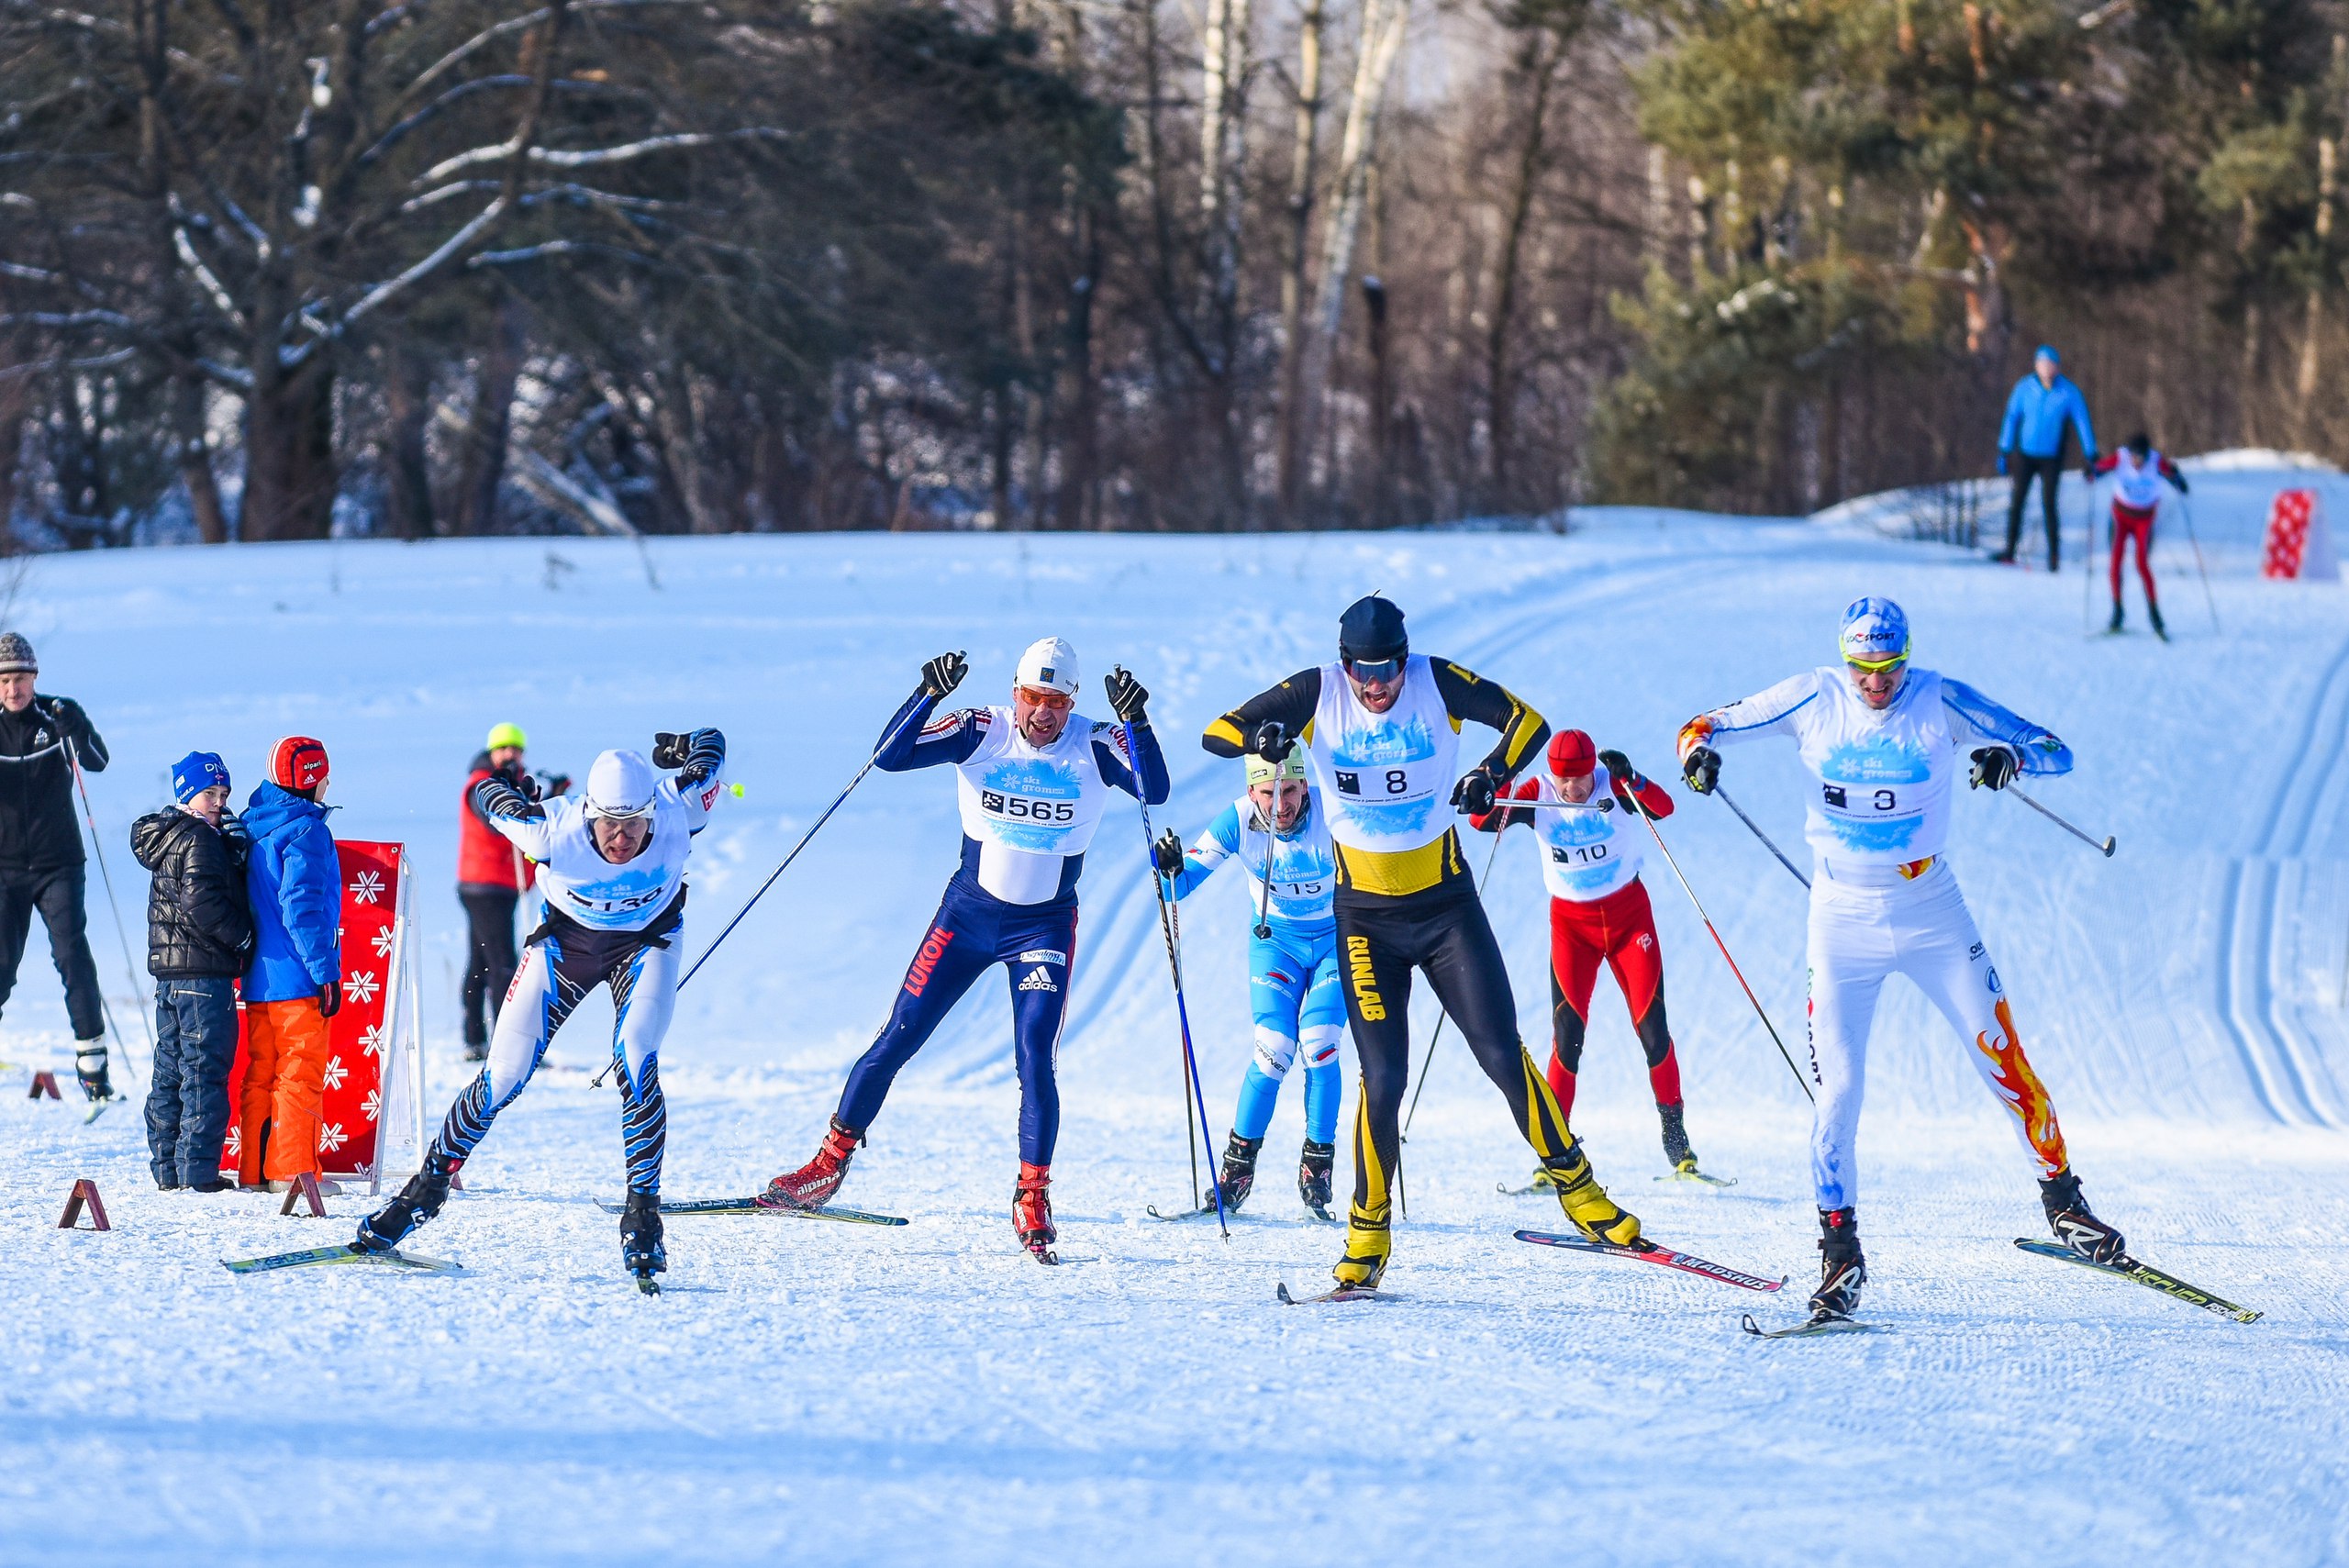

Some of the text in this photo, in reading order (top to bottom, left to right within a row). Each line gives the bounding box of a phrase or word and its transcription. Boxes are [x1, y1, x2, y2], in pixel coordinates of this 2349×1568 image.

[1022, 775, 1041, 785] ski
[1385, 769, 1408, 795] 8
[1008, 796, 1074, 822] 565
[1874, 789, 1897, 811] 3
[1575, 843, 1608, 862] 10
[1286, 881, 1322, 895] 15
[904, 927, 955, 998] LUKOIL
[1018, 981, 1058, 993] adidas
[1347, 936, 1386, 1021] RUNLAB
[1682, 1257, 1769, 1291] MADSHUS
